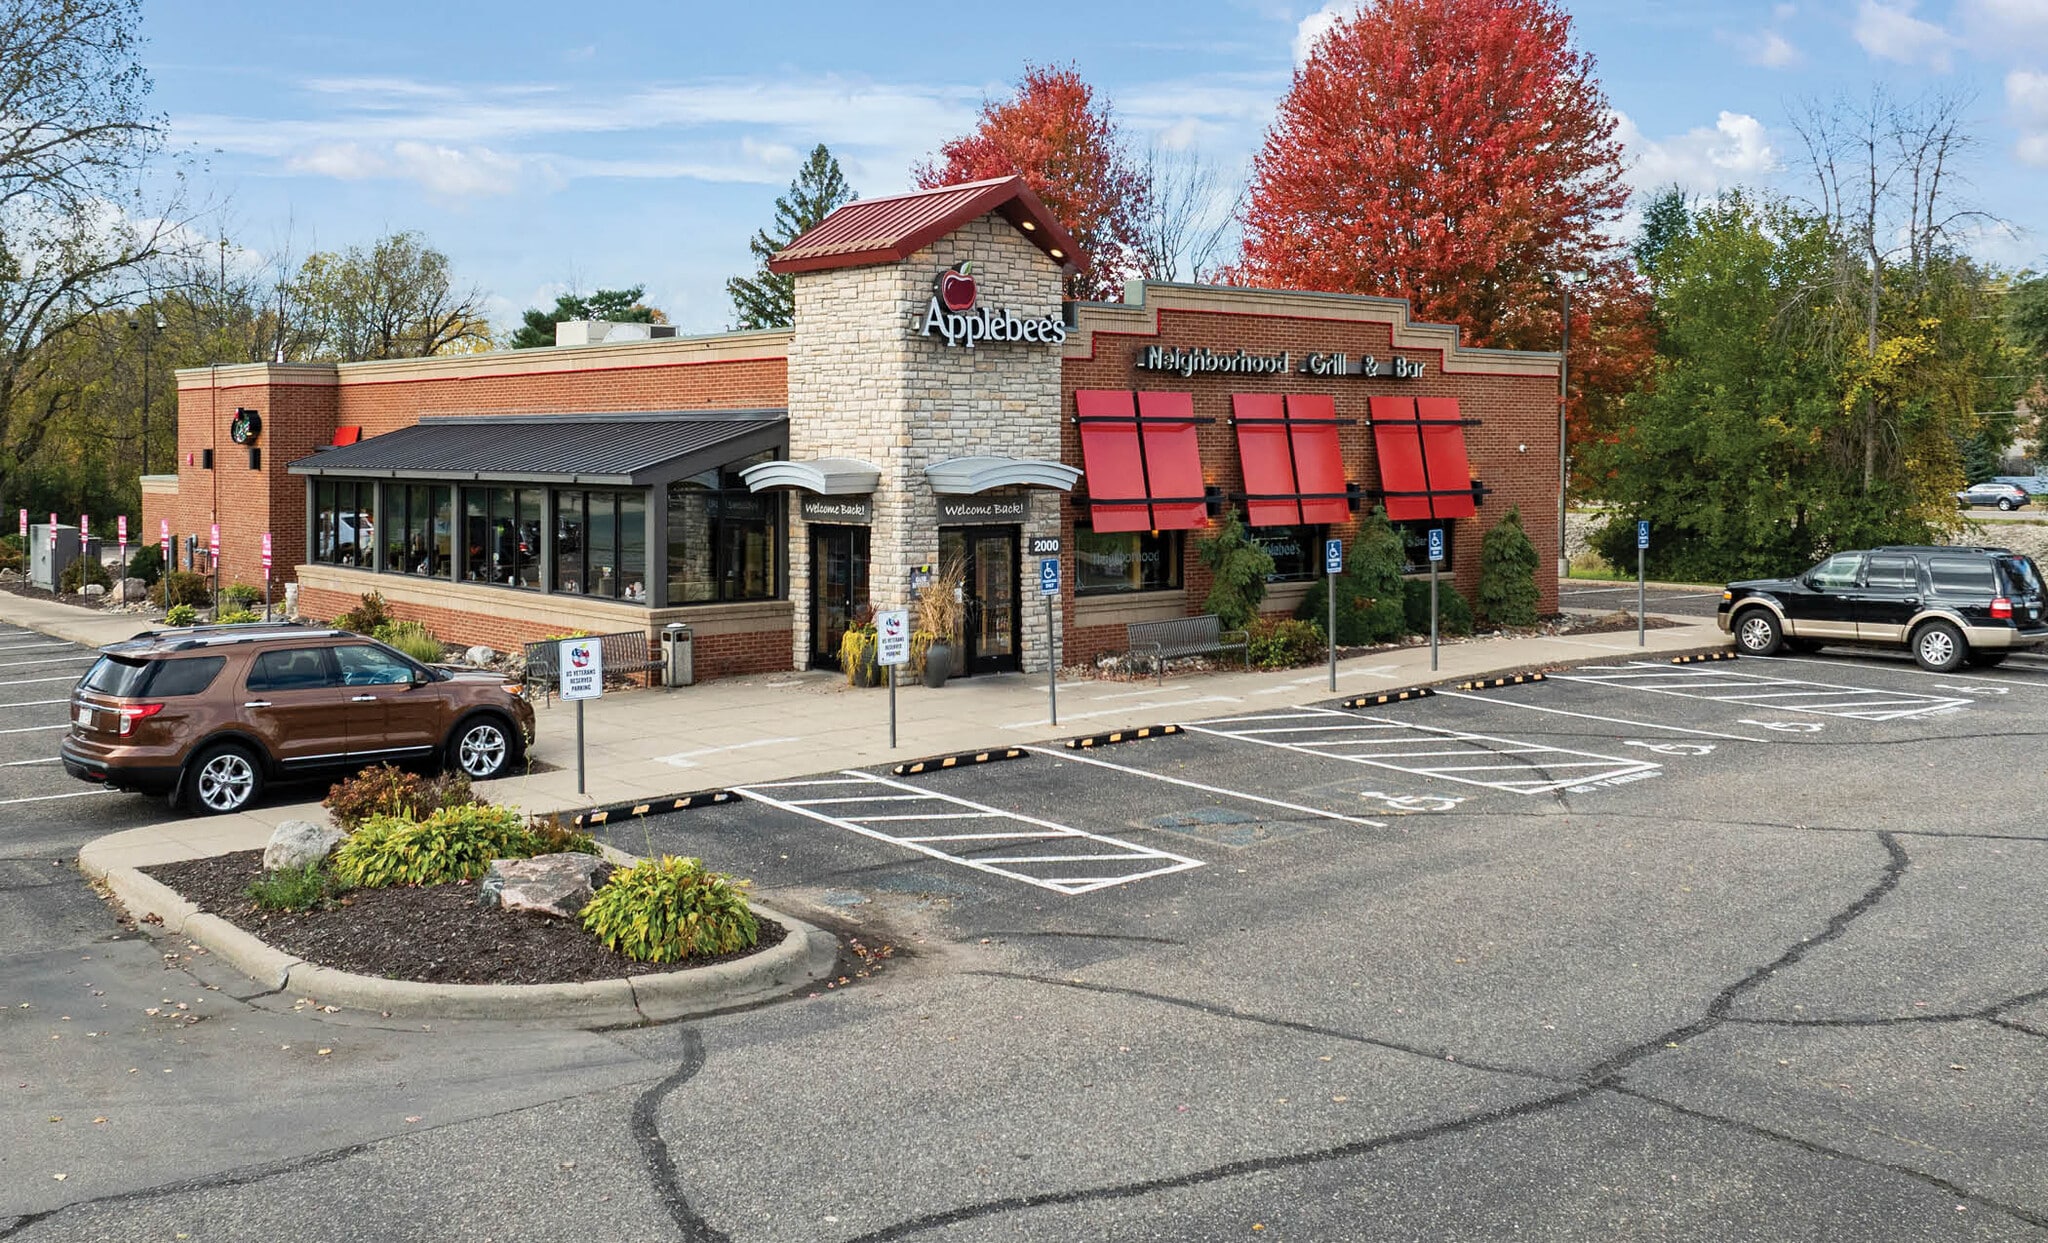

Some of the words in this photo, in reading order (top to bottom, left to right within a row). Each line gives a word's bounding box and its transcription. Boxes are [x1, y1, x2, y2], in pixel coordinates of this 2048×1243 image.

[921, 296, 1066, 348] Applebee's
[1147, 345, 1290, 378] Neighborhood
[1308, 352, 1347, 376] Grill
[1363, 355, 1379, 377] &
[1394, 356, 1426, 378] Bar
[805, 502, 840, 515] Welcome
[840, 503, 865, 516] Back!
[945, 504, 992, 516] Welcome
[993, 502, 1024, 515] Back!
[1034, 539, 1059, 553] 2000
